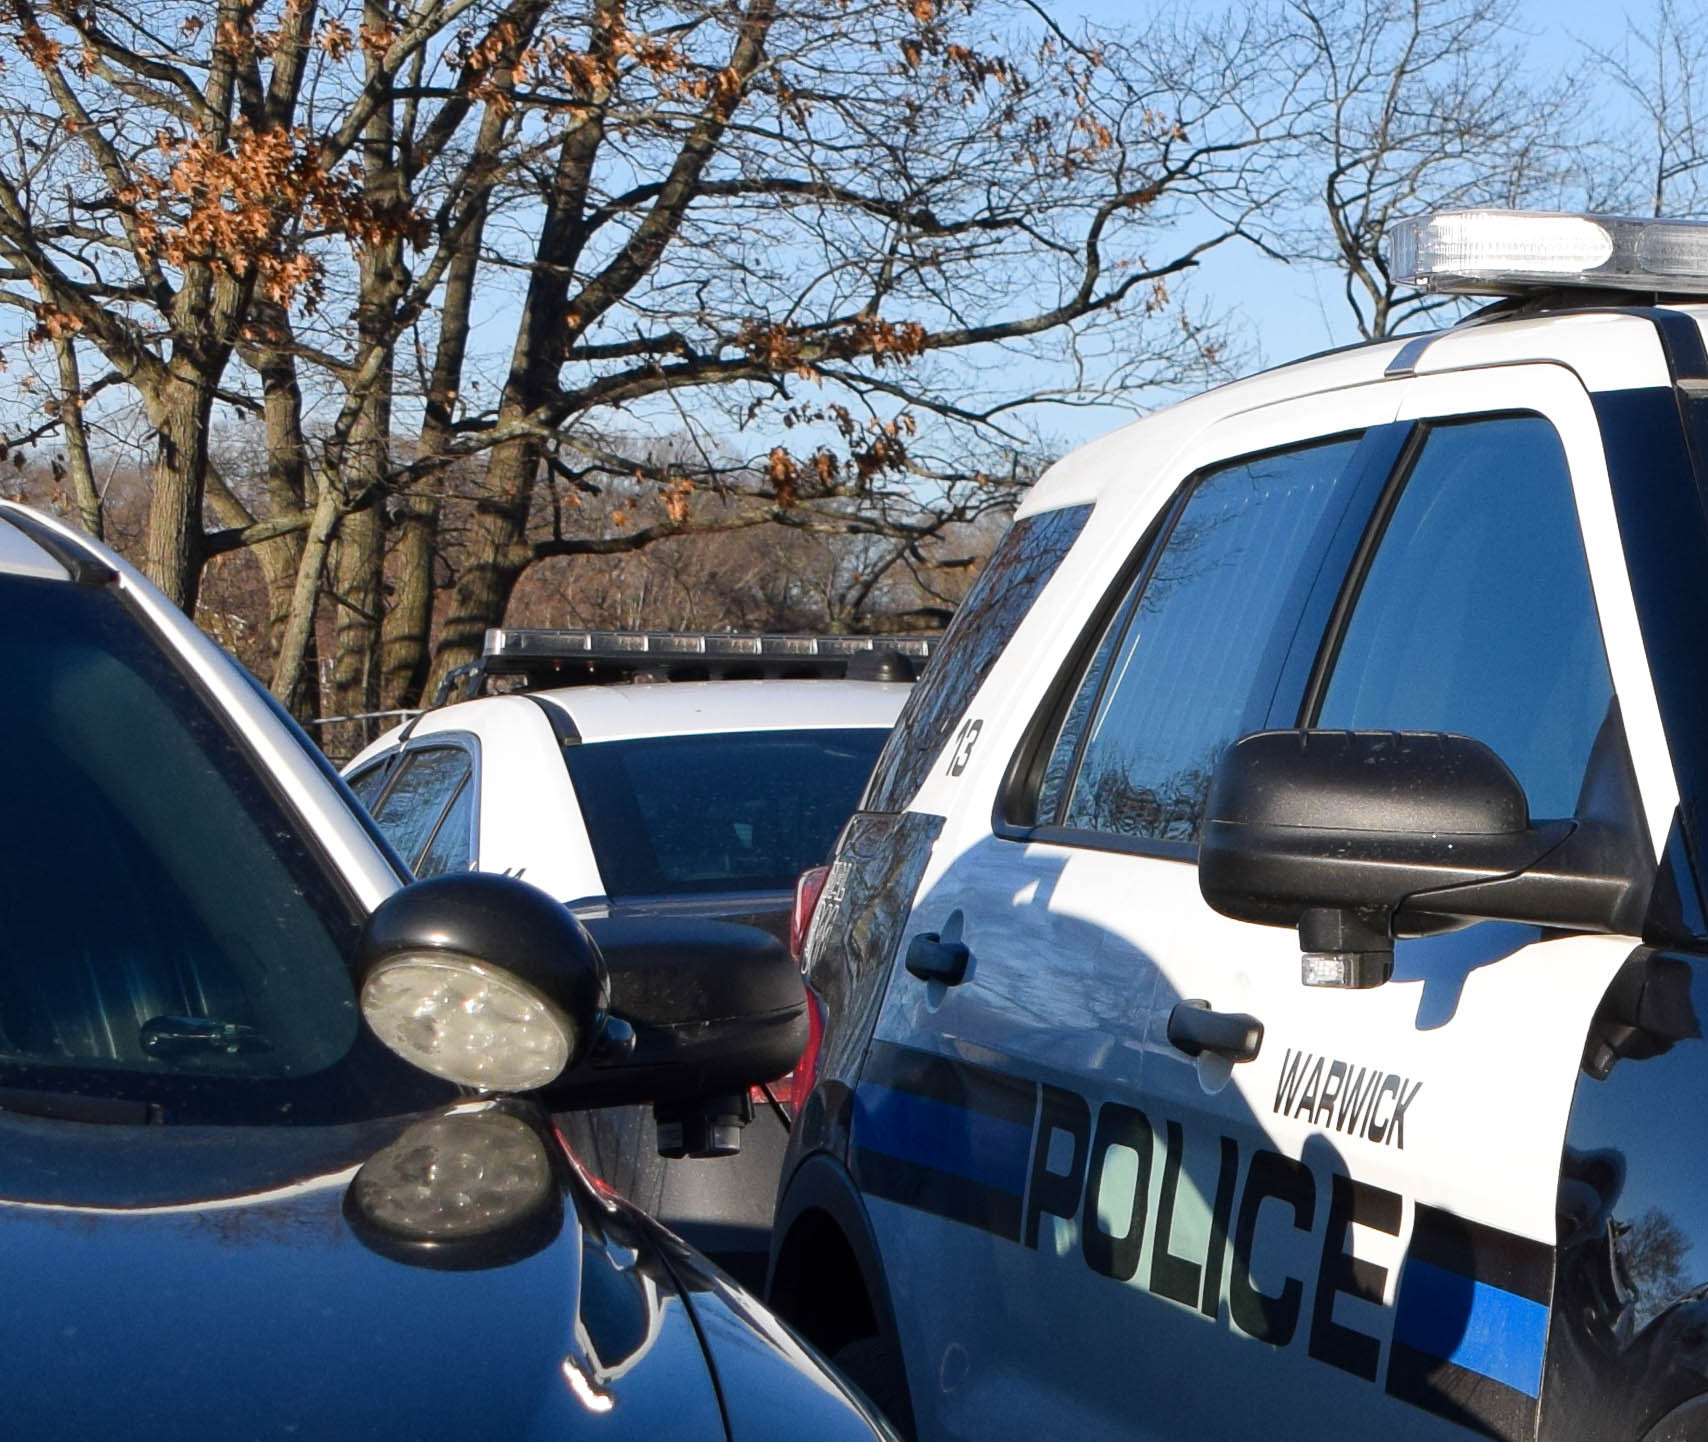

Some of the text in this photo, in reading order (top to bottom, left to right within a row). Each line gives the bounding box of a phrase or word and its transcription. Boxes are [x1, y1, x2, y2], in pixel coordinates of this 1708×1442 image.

[946, 718, 983, 777] 13
[1273, 1048, 1423, 1150] WARWICK
[1026, 1081, 1403, 1384] POLICE
